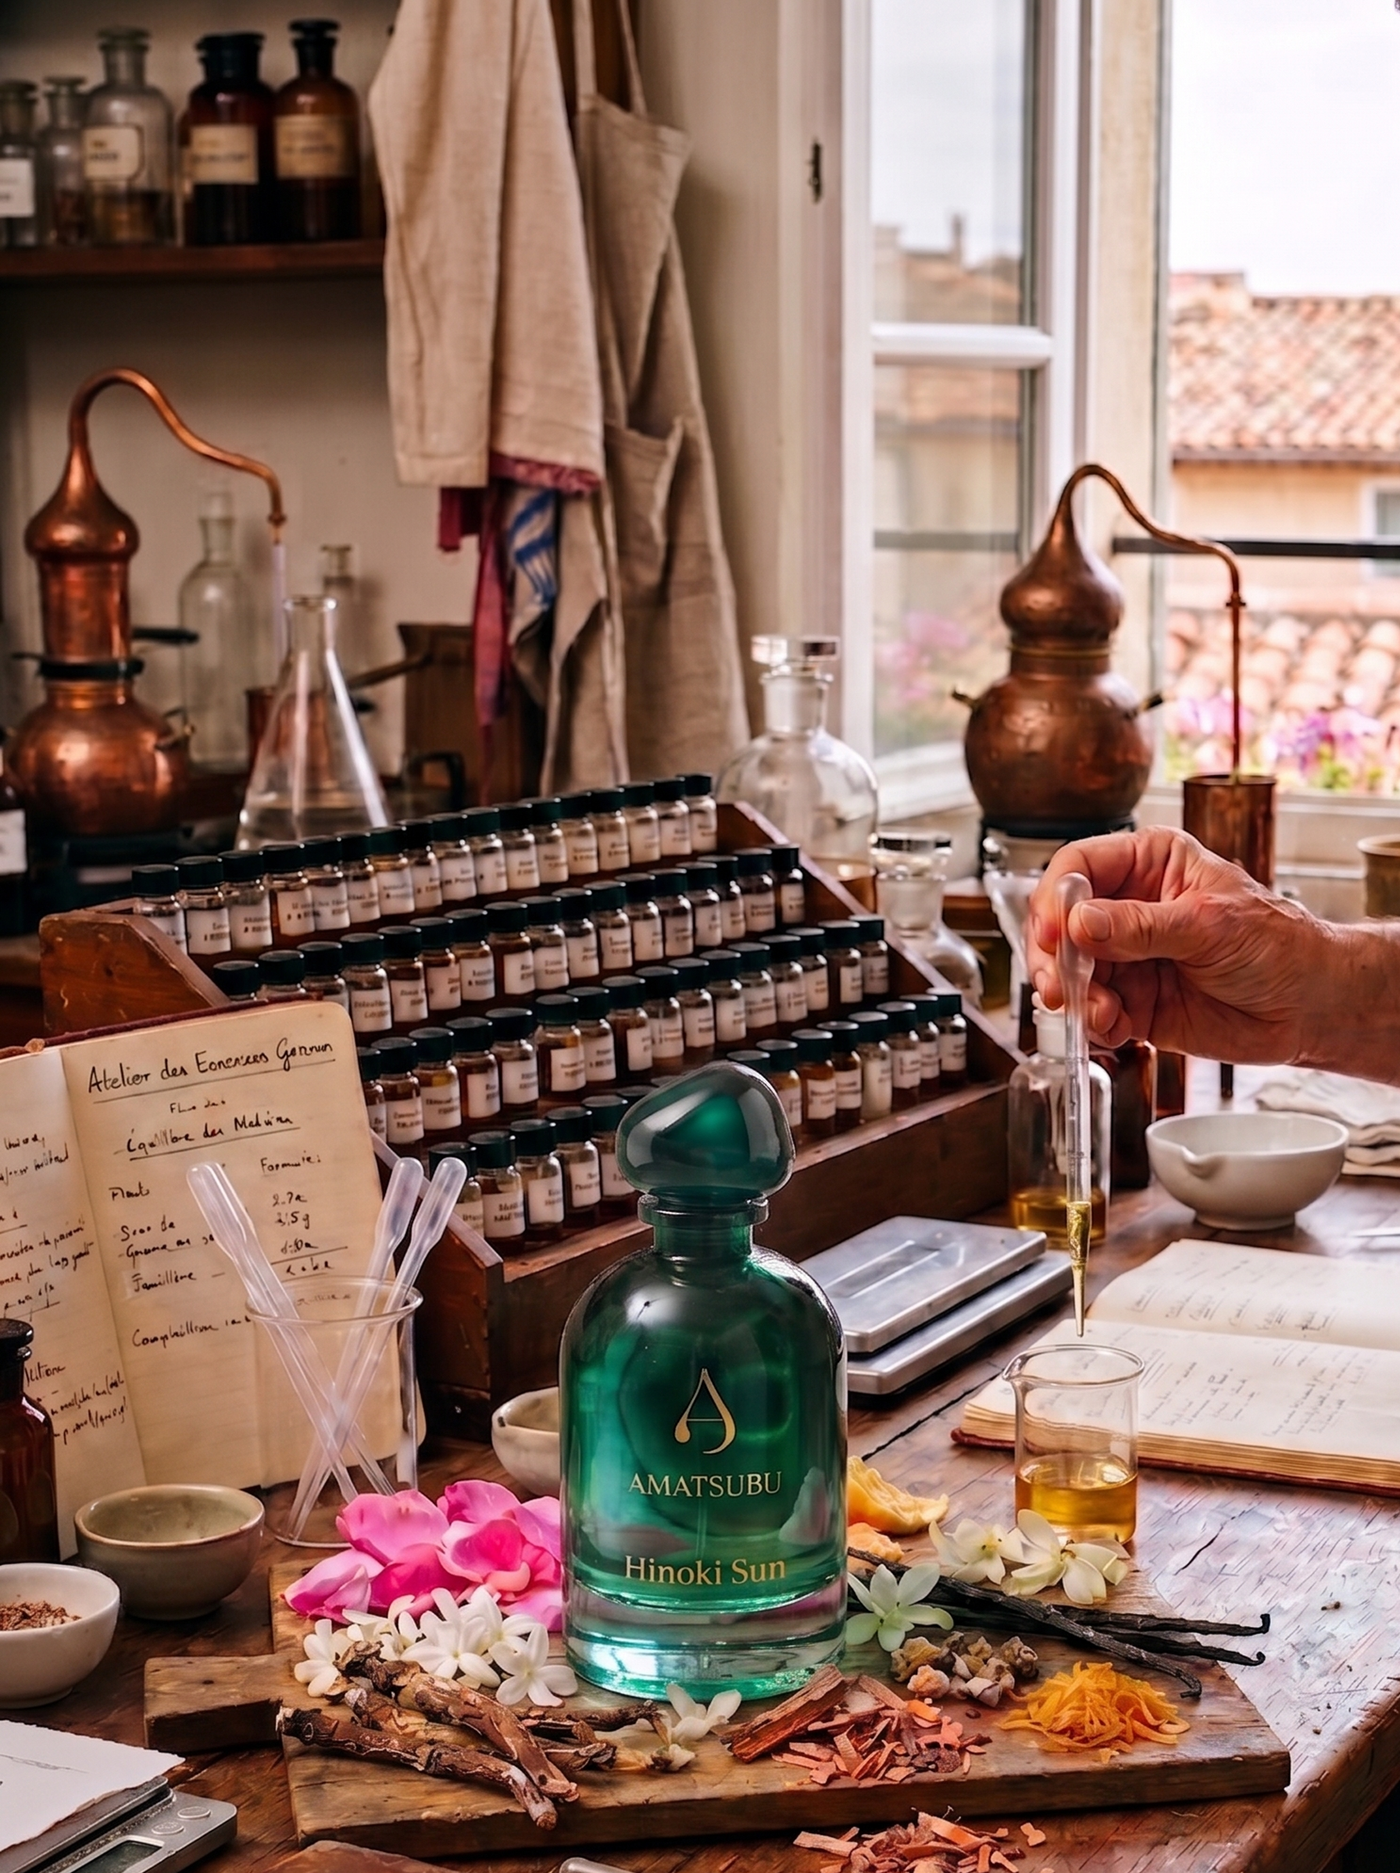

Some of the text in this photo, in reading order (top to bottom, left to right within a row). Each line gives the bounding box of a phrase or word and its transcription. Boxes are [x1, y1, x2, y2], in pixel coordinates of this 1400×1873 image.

[88, 1063, 151, 1093] Atelier
[628, 1472, 783, 1498] AMATSUBU
[624, 1555, 787, 1585] Hinoki Sun
